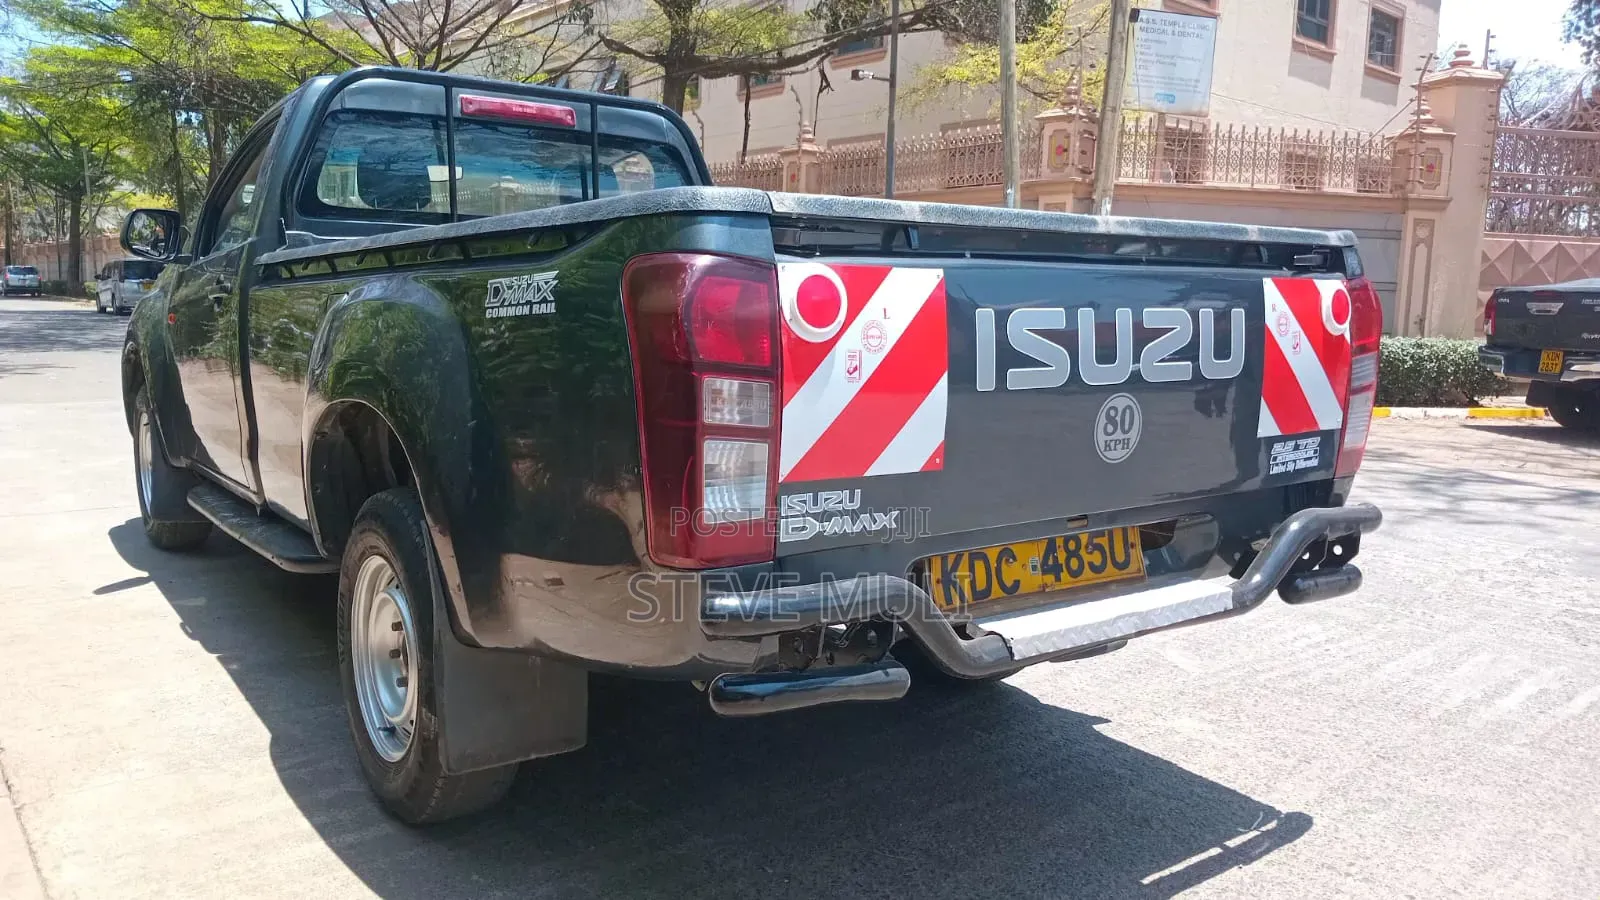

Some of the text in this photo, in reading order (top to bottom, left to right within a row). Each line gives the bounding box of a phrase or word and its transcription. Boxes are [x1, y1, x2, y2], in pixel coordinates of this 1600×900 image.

[1160, 19, 1187, 28] TEMPLE
[1139, 26, 1169, 36] MEDICAL
[1178, 31, 1204, 39] DENTAL
[485, 302, 556, 318] COMMON RAIL
[882, 307, 890, 319] L
[975, 307, 1245, 392] ISUZU
[1103, 404, 1135, 437] 80
[1103, 438, 1131, 453] KPH
[780, 489, 861, 516] ISUZU
[940, 527, 1132, 606] KDC 485U
